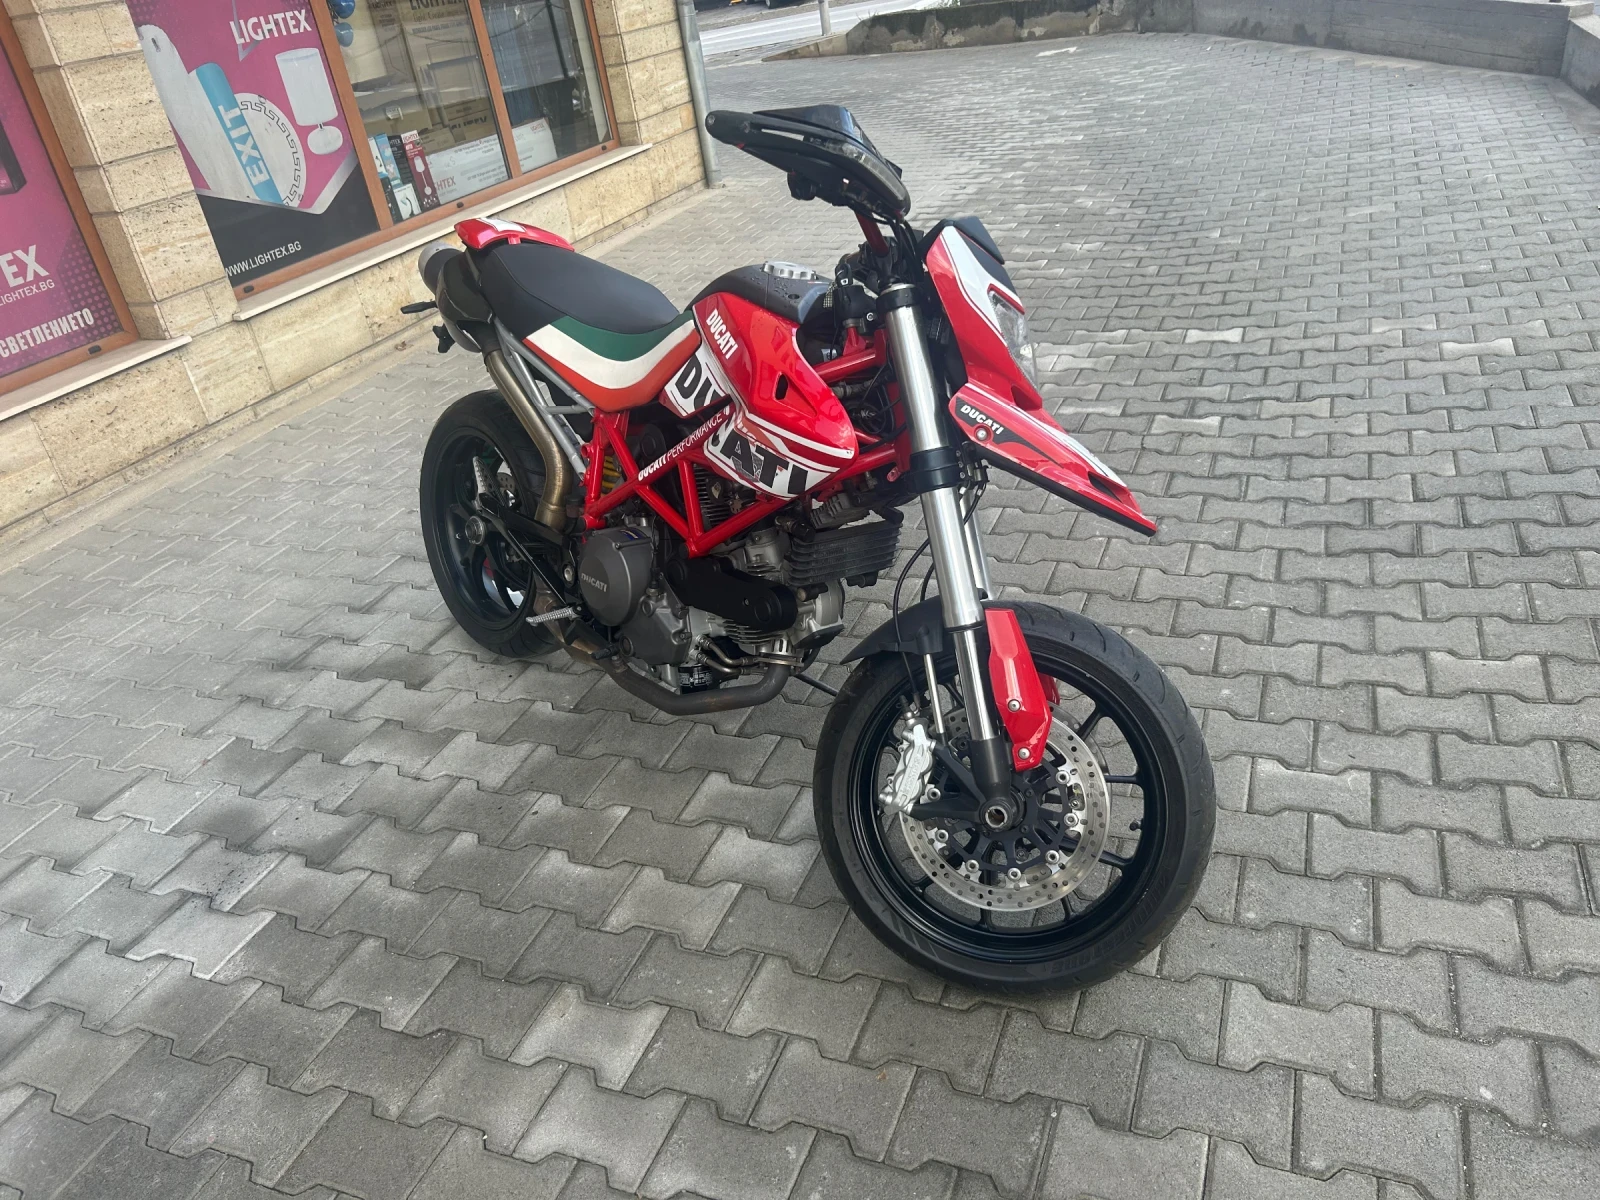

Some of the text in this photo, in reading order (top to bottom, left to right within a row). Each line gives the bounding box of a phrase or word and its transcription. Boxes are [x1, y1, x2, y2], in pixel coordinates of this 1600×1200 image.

[229, 9, 312, 45] LIGHTEX
[218, 104, 270, 186] EXIT
[0, 307, 95, 358] СВЕТЛЕНИЕТО
[706, 308, 739, 360] DUCATI
[960, 404, 1005, 435] DUCATI
[638, 453, 667, 481] DUCATI
[667, 413, 723, 461] PERFORMANCE
[580, 572, 608, 593] DUCATI
